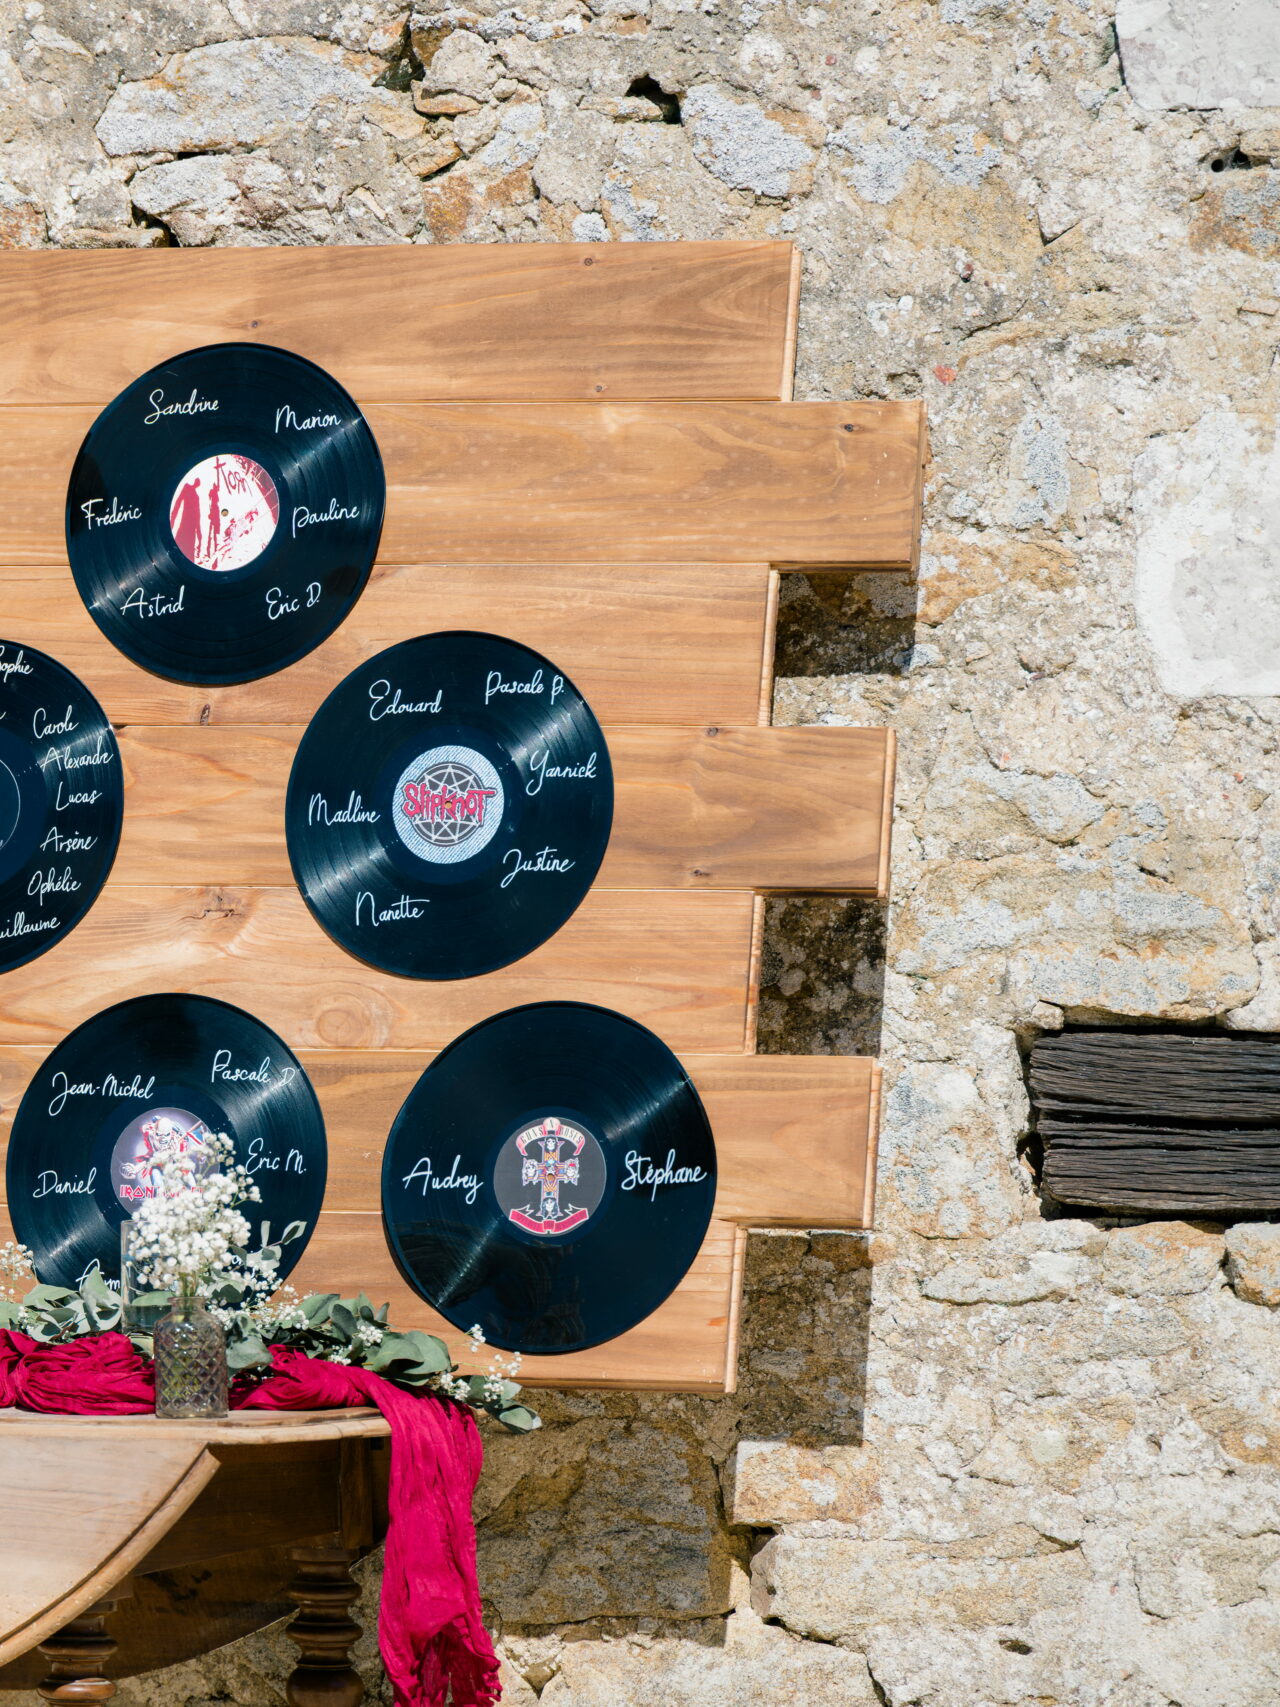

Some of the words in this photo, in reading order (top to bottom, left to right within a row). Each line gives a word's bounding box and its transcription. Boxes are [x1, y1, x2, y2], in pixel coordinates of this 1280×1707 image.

[143, 388, 219, 425] Sandrine
[275, 405, 341, 433] Marion
[81, 496, 142, 530] Frédéric
[292, 498, 359, 538] Pauline
[120, 585, 185, 619] Astrid
[265, 587, 300, 620] Eric
[369, 679, 443, 721] Edouard
[485, 669, 544, 705] Pascale
[33, 705, 80, 739] Carole
[39, 736, 113, 772] Alexandre
[526, 750, 597, 796] Yannick
[55, 782, 102, 811] Lucas
[40, 826, 97, 852] Arsène
[500, 846, 576, 888] Justine
[27, 867, 81, 906] Ophélie
[355, 891, 430, 927] Nanette
[211, 1049, 271, 1083] Pascale
[48, 1071, 156, 1116] Jean-Michel
[245, 1137, 280, 1175] Eric
[32, 1167, 97, 1198] Daniel
[120, 1184, 155, 1202] IRON
[402, 1154, 484, 1204] Audrey
[621, 1148, 707, 1202] Stéphane
